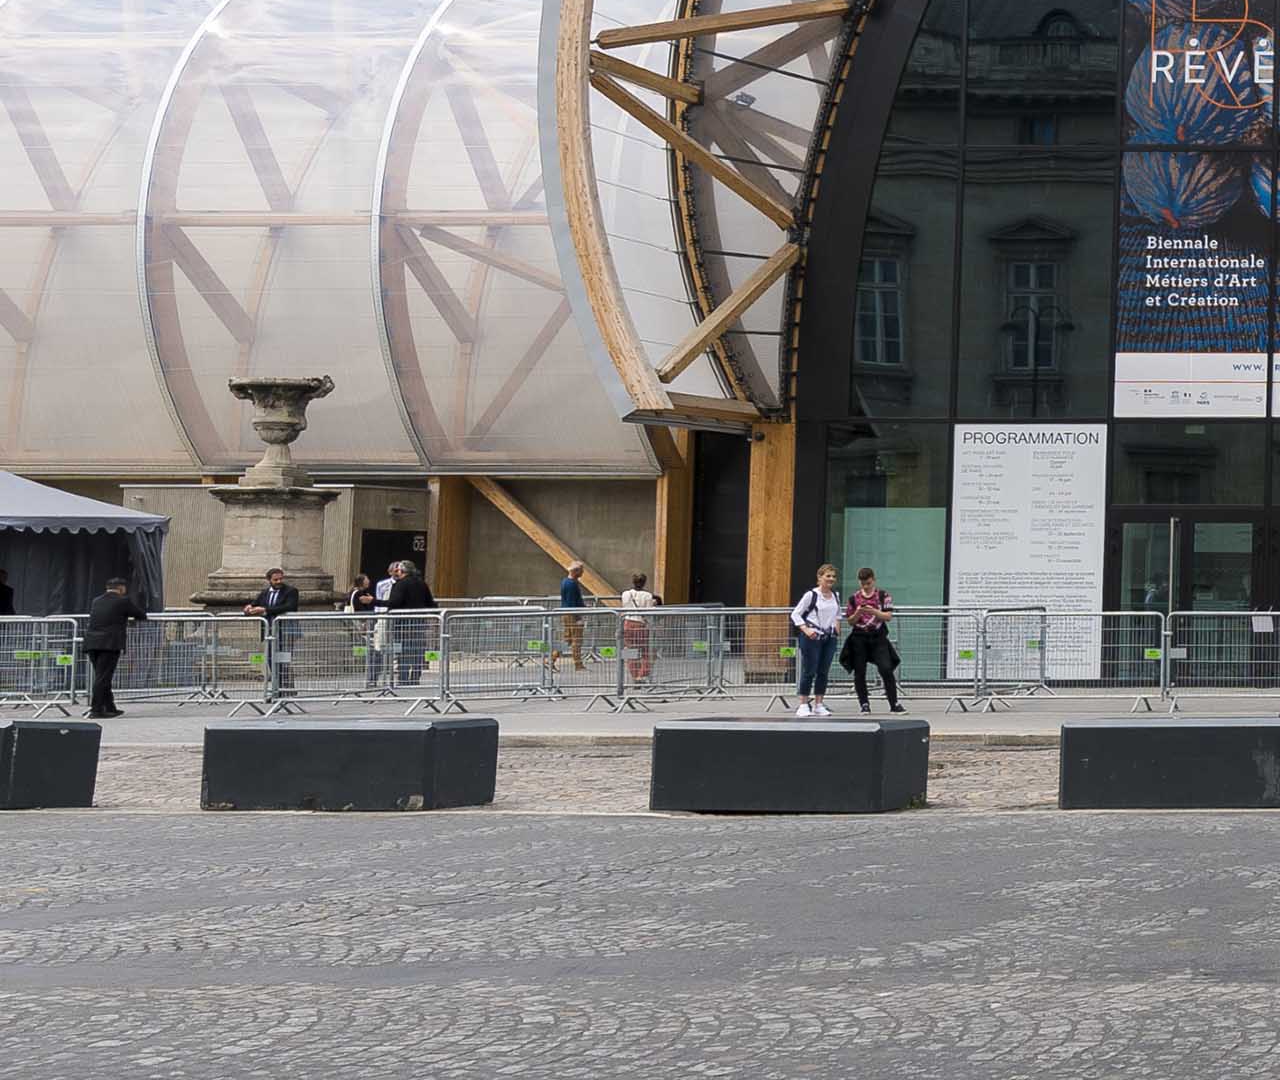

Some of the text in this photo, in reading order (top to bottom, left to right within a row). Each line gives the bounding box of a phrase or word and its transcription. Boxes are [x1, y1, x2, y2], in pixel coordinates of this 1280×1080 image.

[1146, 234, 1219, 250] Biennale
[1145, 253, 1265, 269] Internationale
[1145, 273, 1209, 288] Métiers
[1145, 292, 1240, 307] et Création
[962, 431, 1100, 446] PROGRAMMATION
